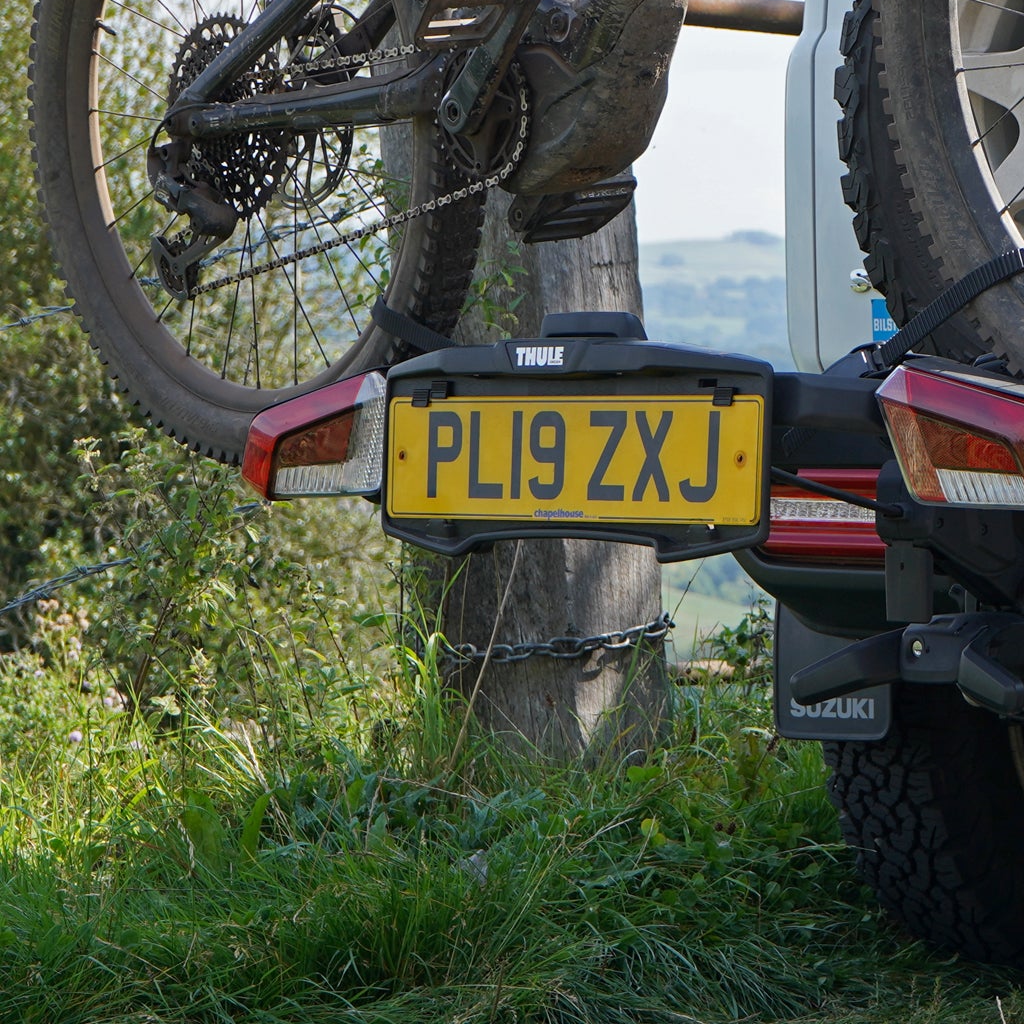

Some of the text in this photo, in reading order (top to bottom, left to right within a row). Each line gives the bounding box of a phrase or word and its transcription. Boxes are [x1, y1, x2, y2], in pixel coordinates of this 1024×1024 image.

[873, 318, 897, 332] BILST
[515, 345, 565, 367] THULE
[426, 411, 721, 503] PL19 ZXJ
[534, 508, 584, 520] chapelhouse
[789, 696, 875, 720] SUZUKI
